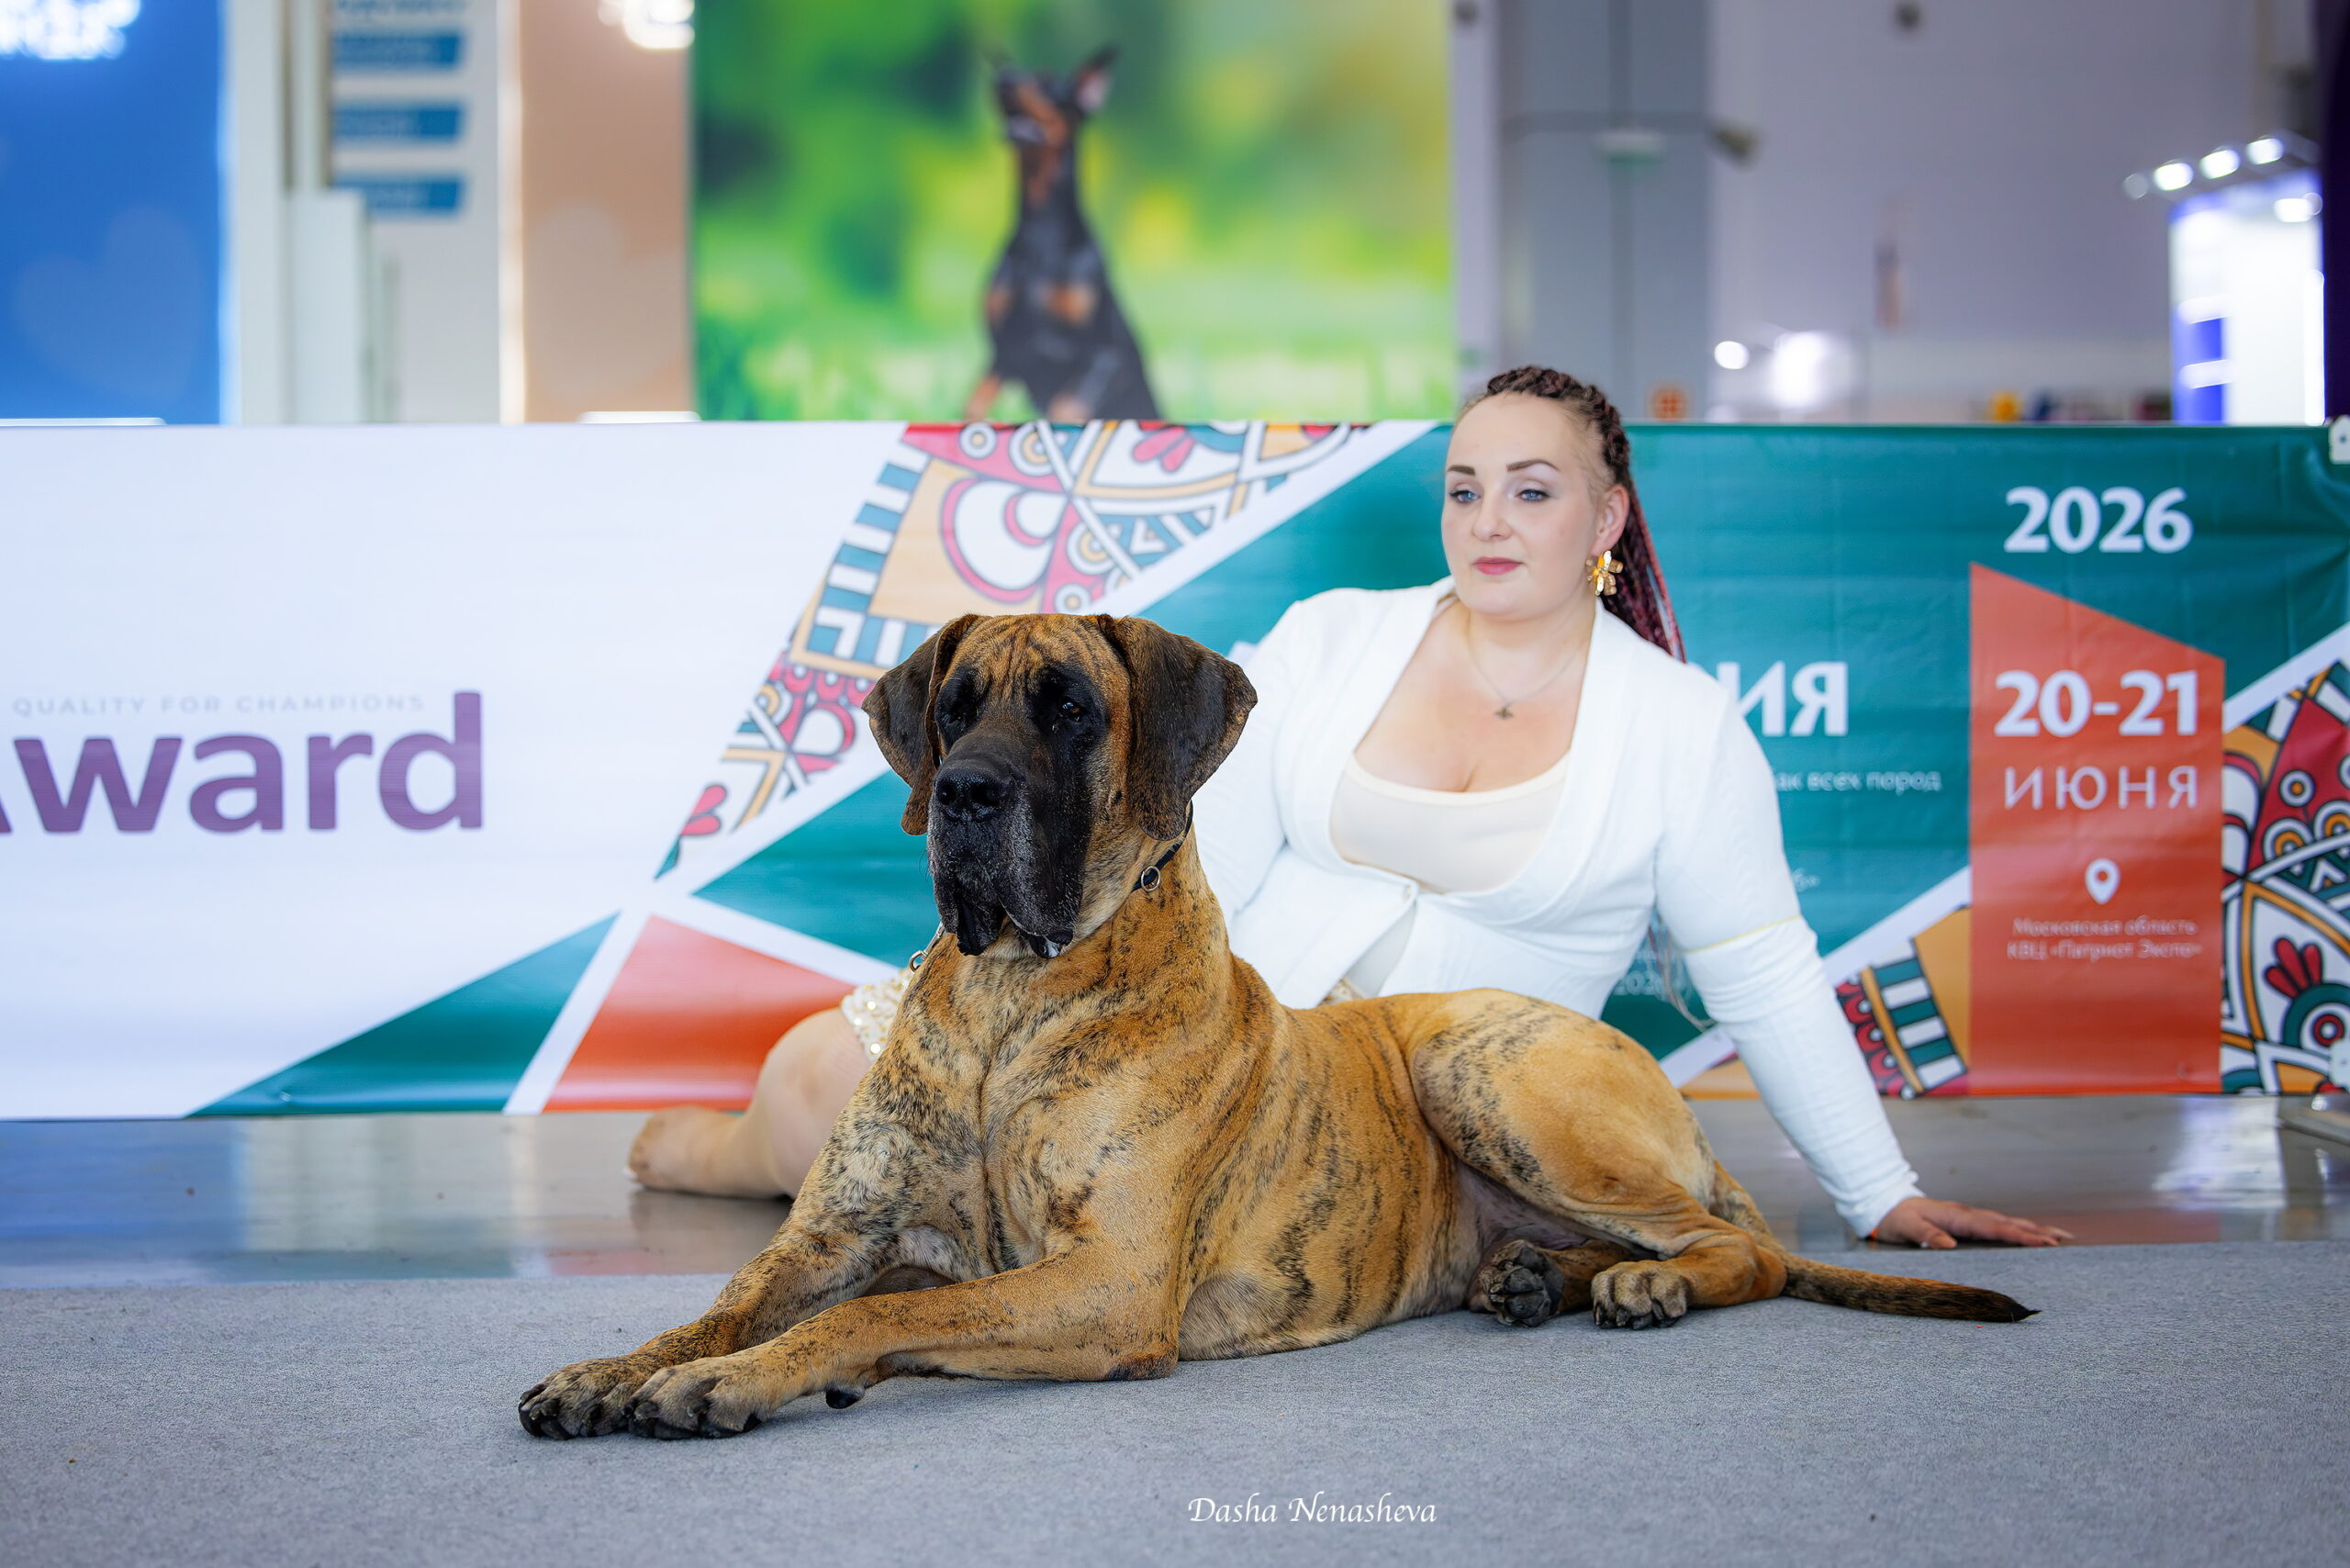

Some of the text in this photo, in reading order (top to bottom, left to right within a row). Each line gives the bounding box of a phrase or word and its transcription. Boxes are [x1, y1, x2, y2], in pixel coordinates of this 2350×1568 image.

[2004, 487, 2193, 553] 2026
[12, 694, 426, 716] QUALITY FOR CHAMPIONS
[1691, 660, 1848, 736] ИЯ
[1994, 670, 2199, 736] 20-21
[0, 690, 482, 833] ward
[1807, 771, 1863, 791] всех
[1866, 771, 1942, 796] пород
[2005, 766, 2199, 810] ИЮНЯ
